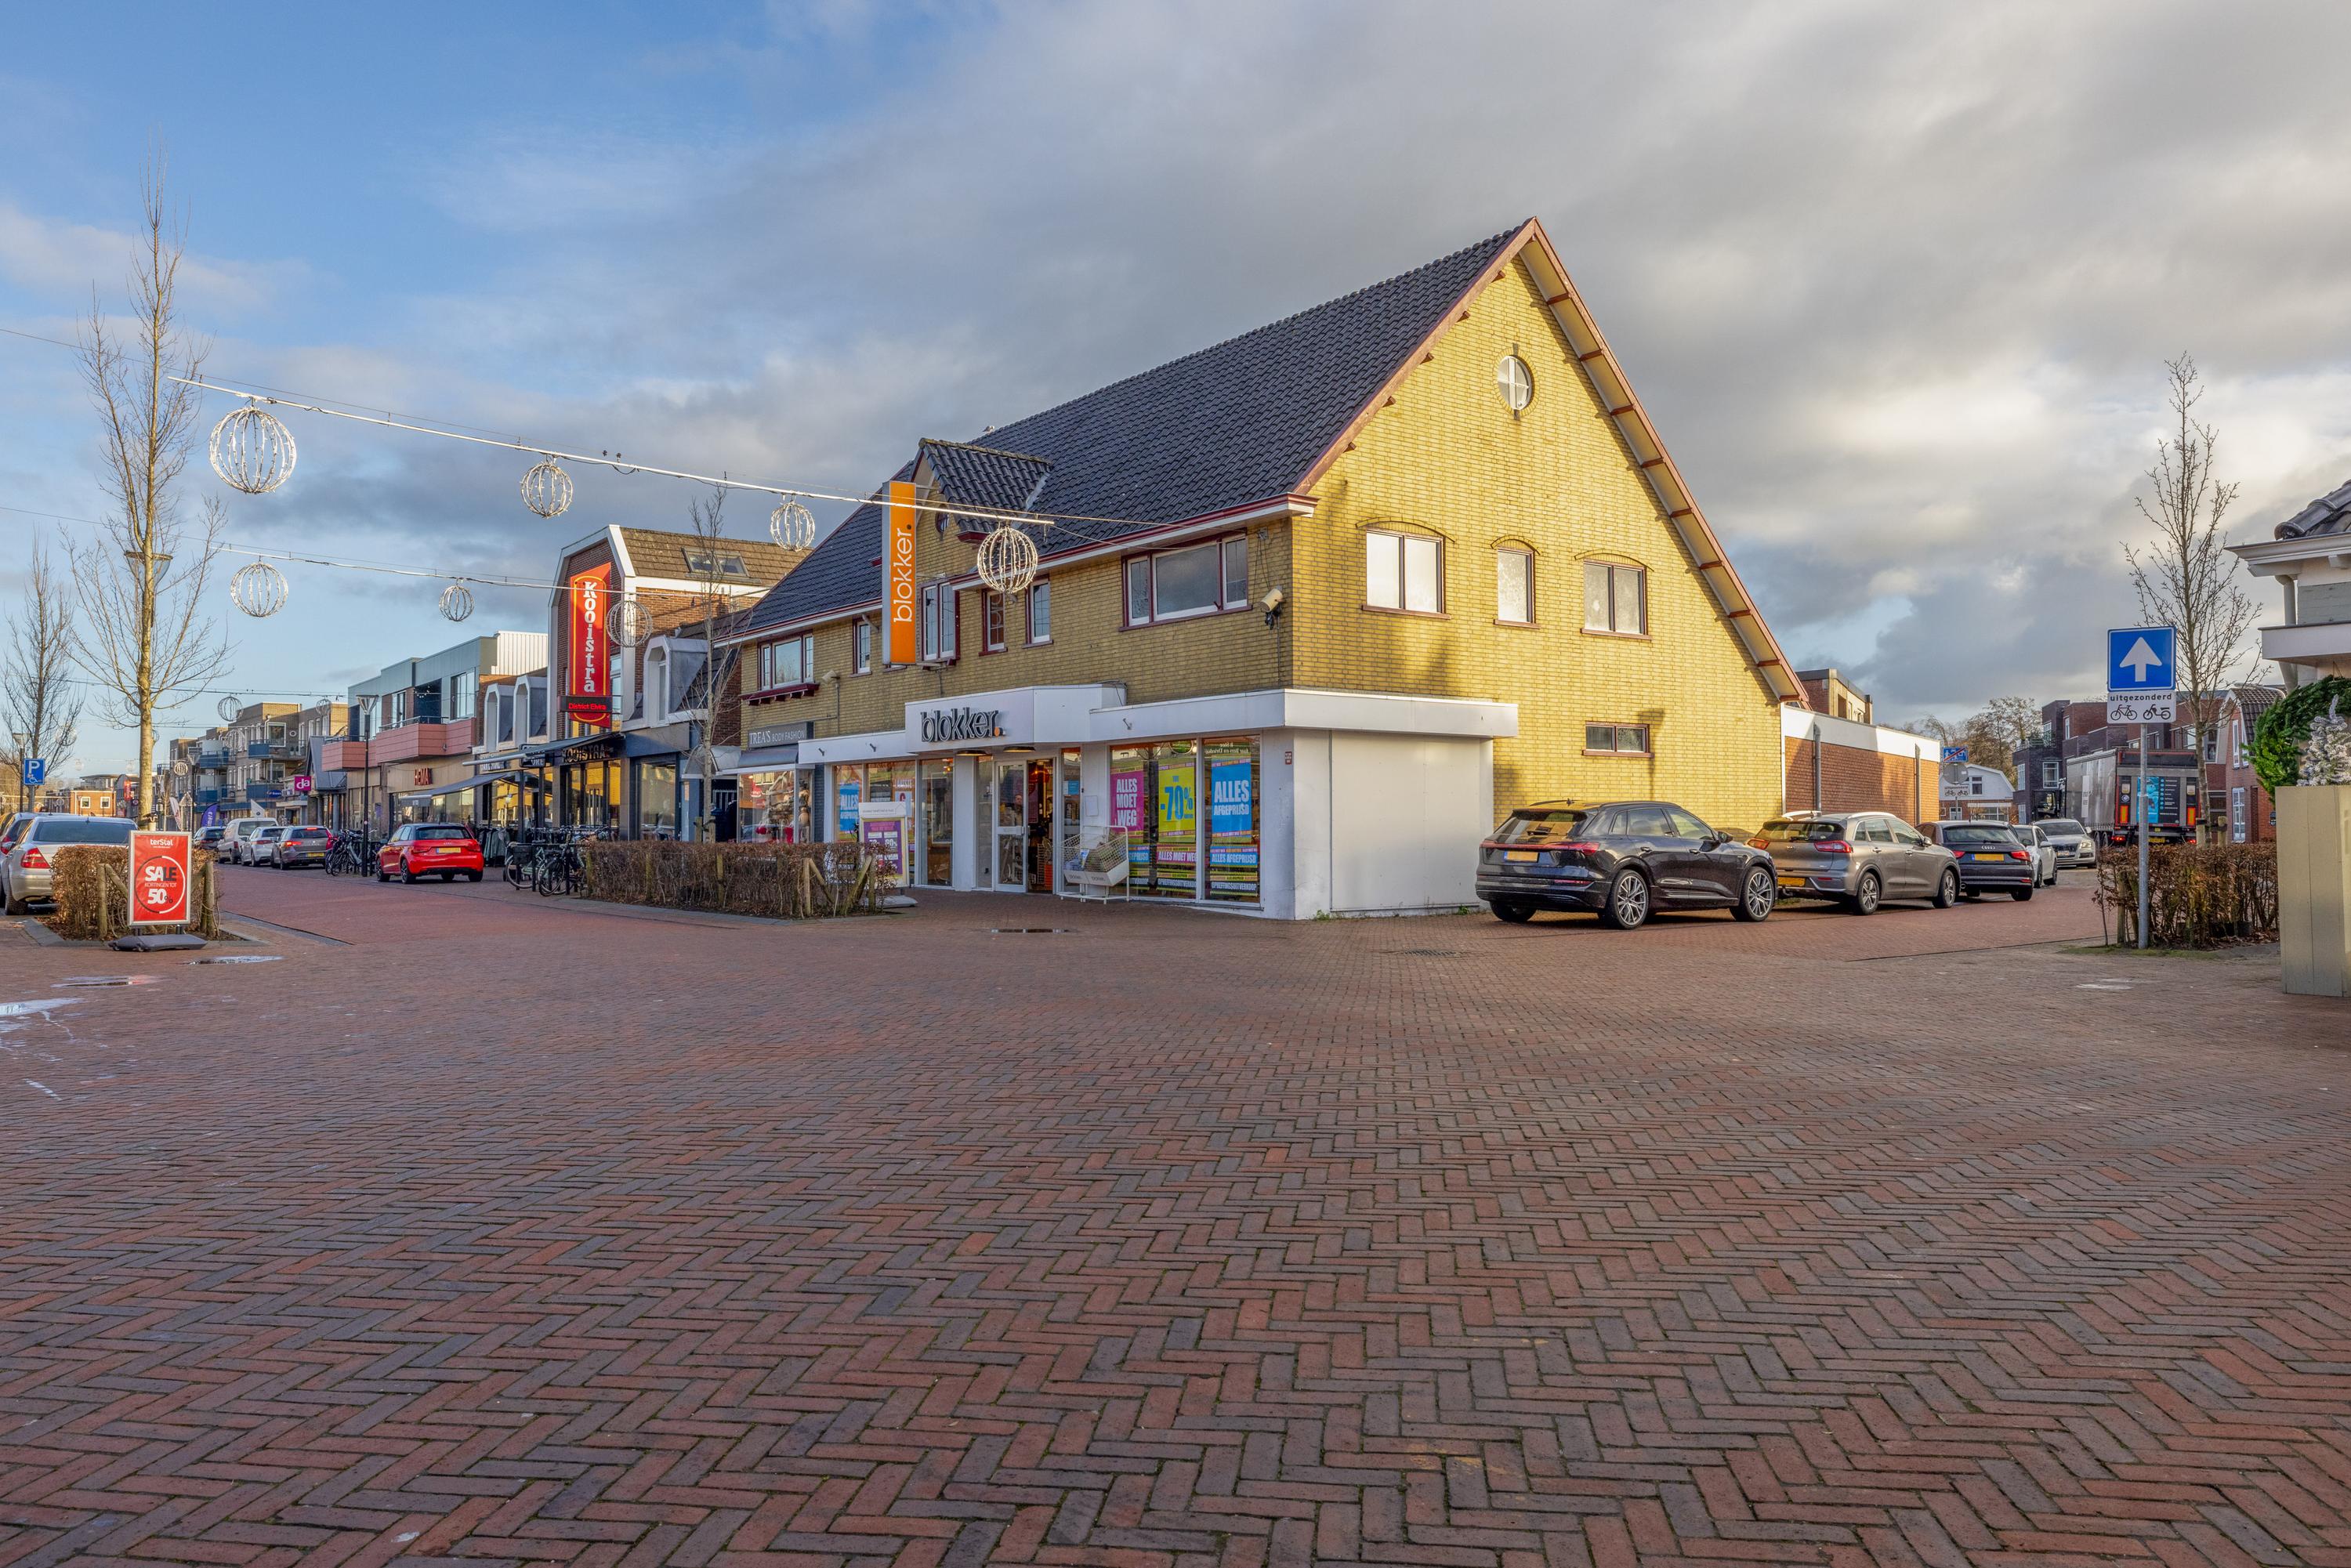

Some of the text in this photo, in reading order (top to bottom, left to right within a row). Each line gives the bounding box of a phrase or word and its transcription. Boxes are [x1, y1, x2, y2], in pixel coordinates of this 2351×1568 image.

[893, 523, 913, 623] blokker.
[583, 581, 598, 693] Kooistra
[2110, 693, 2172, 702] uitgezonderd
[920, 707, 1003, 742] blokker.
[749, 730, 805, 744] TREA'S BODY FASHION
[29, 760, 40, 774] P
[296, 778, 310, 789] da
[415, 767, 429, 786] HEMA
[1116, 777, 1138, 793] ALLES
[1214, 780, 1249, 802] ALLES
[841, 794, 859, 809] ALLES
[1116, 793, 1138, 809] MOET
[1160, 785, 1193, 821] -70%
[1213, 803, 1249, 816] AFGEPRIJSD
[1117, 809, 1137, 827] WEG
[1158, 850, 1173, 860] ALLES
[1172, 852, 1187, 861] MOET
[1212, 853, 1256, 864] ALLES AFGEPRIJSD
[144, 866, 177, 882] SALE
[147, 888, 173, 905] 50%
